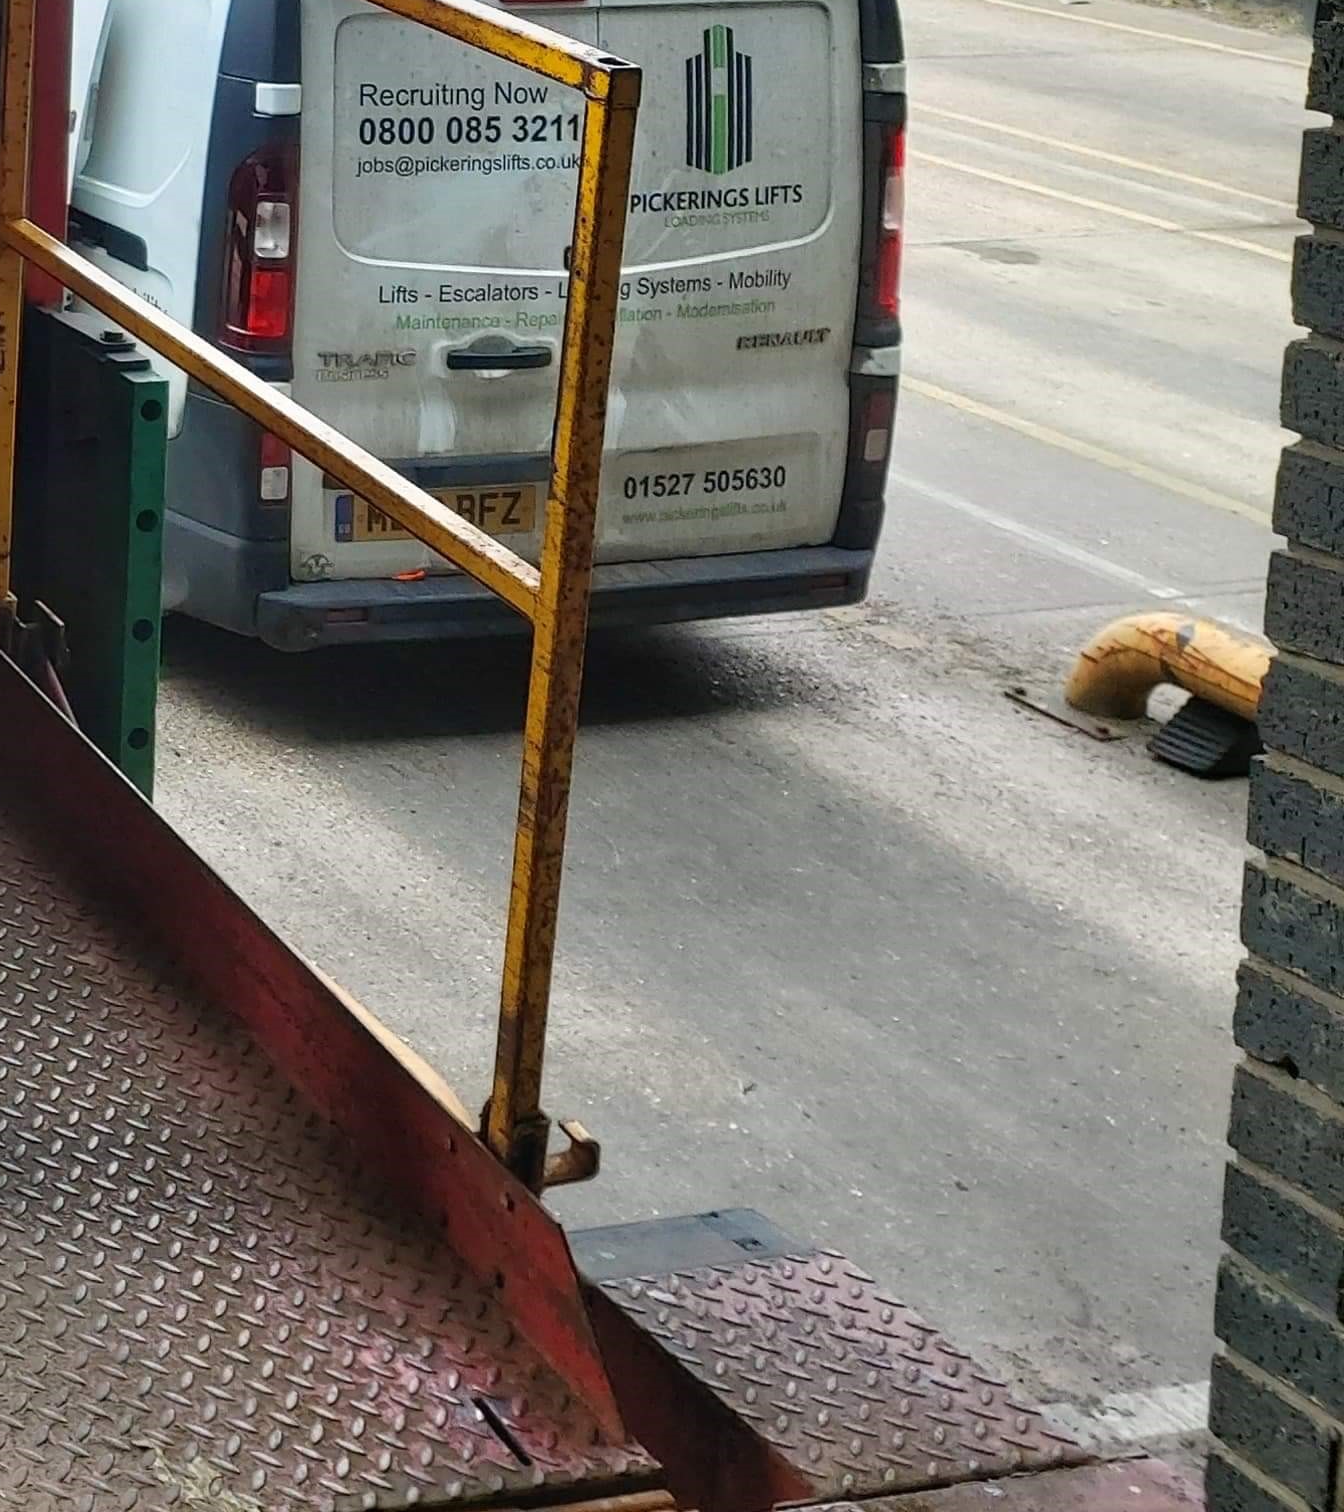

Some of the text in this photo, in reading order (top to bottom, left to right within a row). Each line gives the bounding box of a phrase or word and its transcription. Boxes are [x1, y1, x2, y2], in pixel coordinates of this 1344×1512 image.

[359, 81, 548, 111] Recruiting Now
[359, 113, 580, 145] 0800 085 3211
[355, 153, 580, 177] jobs@pickeringslifts.co.uk
[629, 184, 803, 214] PICKERINGS LIFTS
[378, 284, 419, 304] Lifts
[439, 283, 539, 303] Escalators
[636, 276, 712, 300] Systems
[728, 270, 792, 291] Mobility
[395, 314, 501, 331] Maintenance
[515, 311, 561, 330] Repai
[676, 299, 775, 320] Modernisation
[623, 469, 786, 499] 01527 505630
